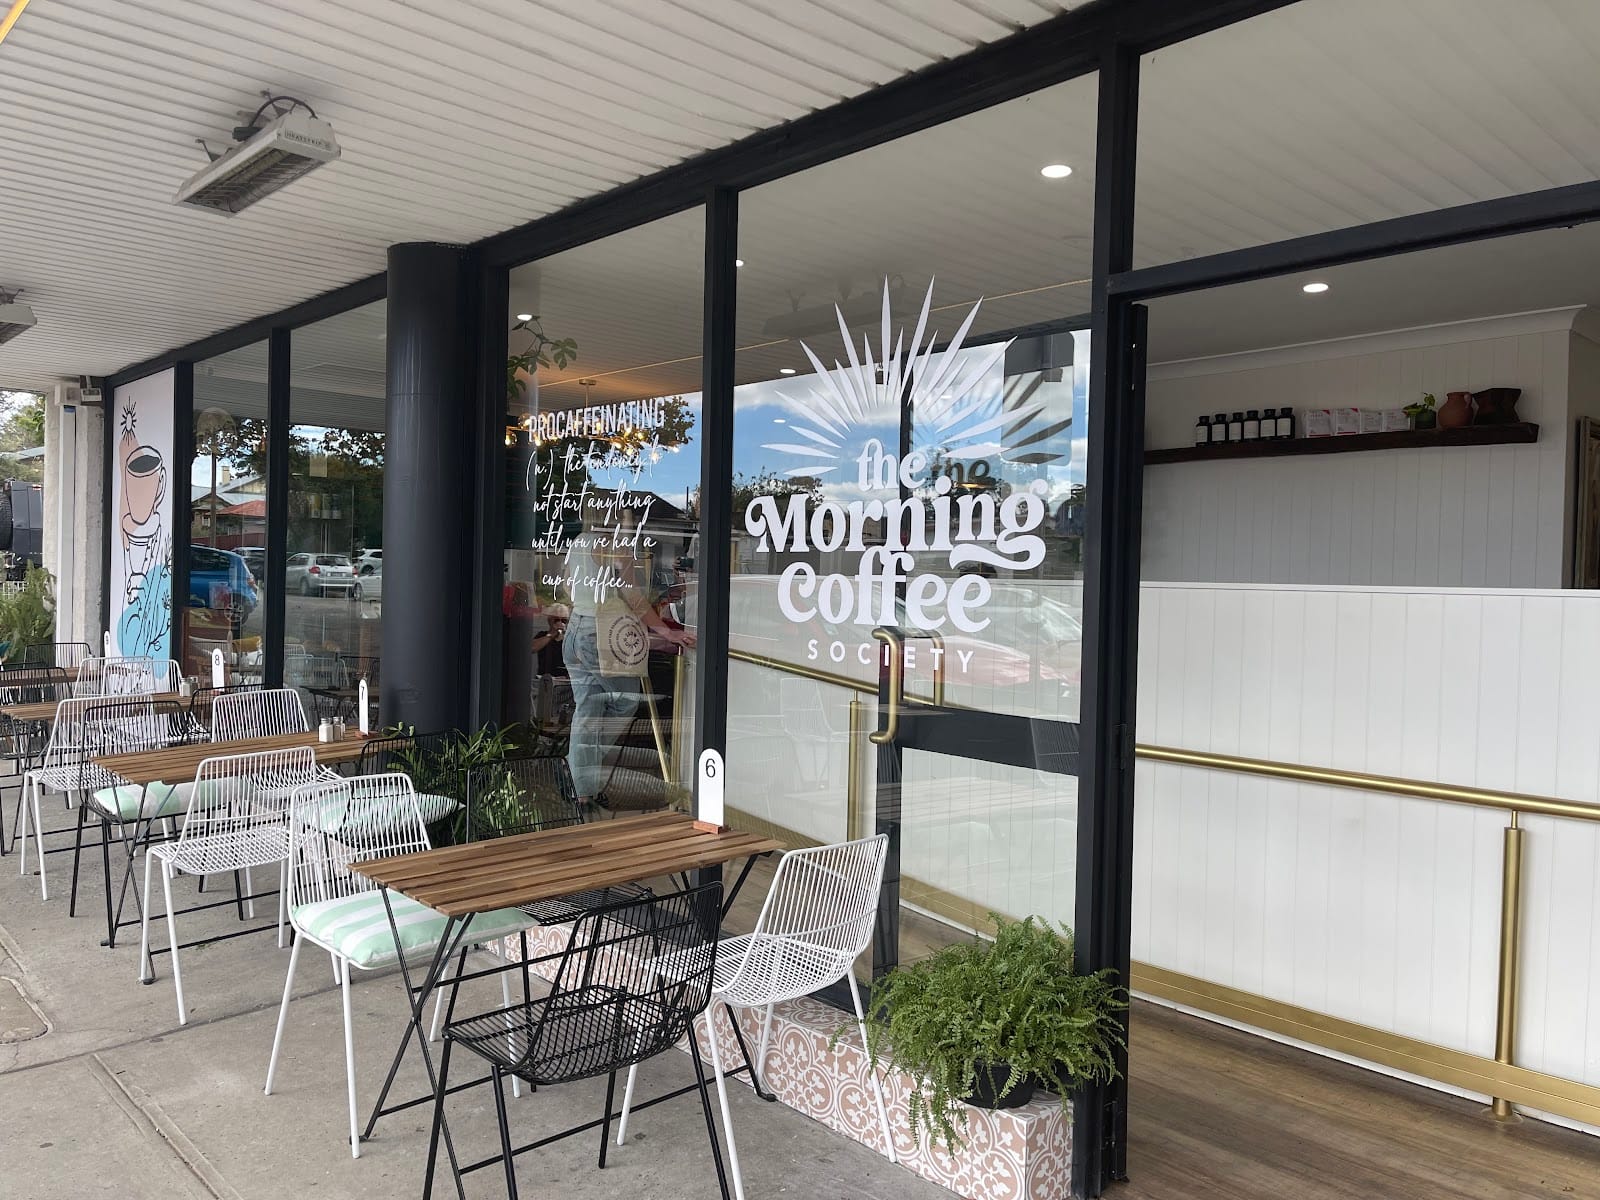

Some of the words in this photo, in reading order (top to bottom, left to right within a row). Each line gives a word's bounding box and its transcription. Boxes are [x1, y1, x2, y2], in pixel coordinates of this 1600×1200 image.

[528, 397, 665, 443] PROCAFFEINATING
[559, 443, 584, 482] the
[856, 438, 928, 492] the
[533, 483, 557, 521] not
[552, 480, 594, 521] start
[587, 479, 656, 525] anything
[531, 520, 564, 559] until
[612, 522, 639, 561] had
[643, 537, 657, 549] a
[744, 475, 1050, 571] Morning
[542, 574, 564, 600] cup
[566, 565, 582, 602] of
[777, 545, 993, 633] Coffee
[214, 654, 220, 666] 8
[808, 639, 975, 673] SOCIETY
[705, 757, 716, 778] 6
